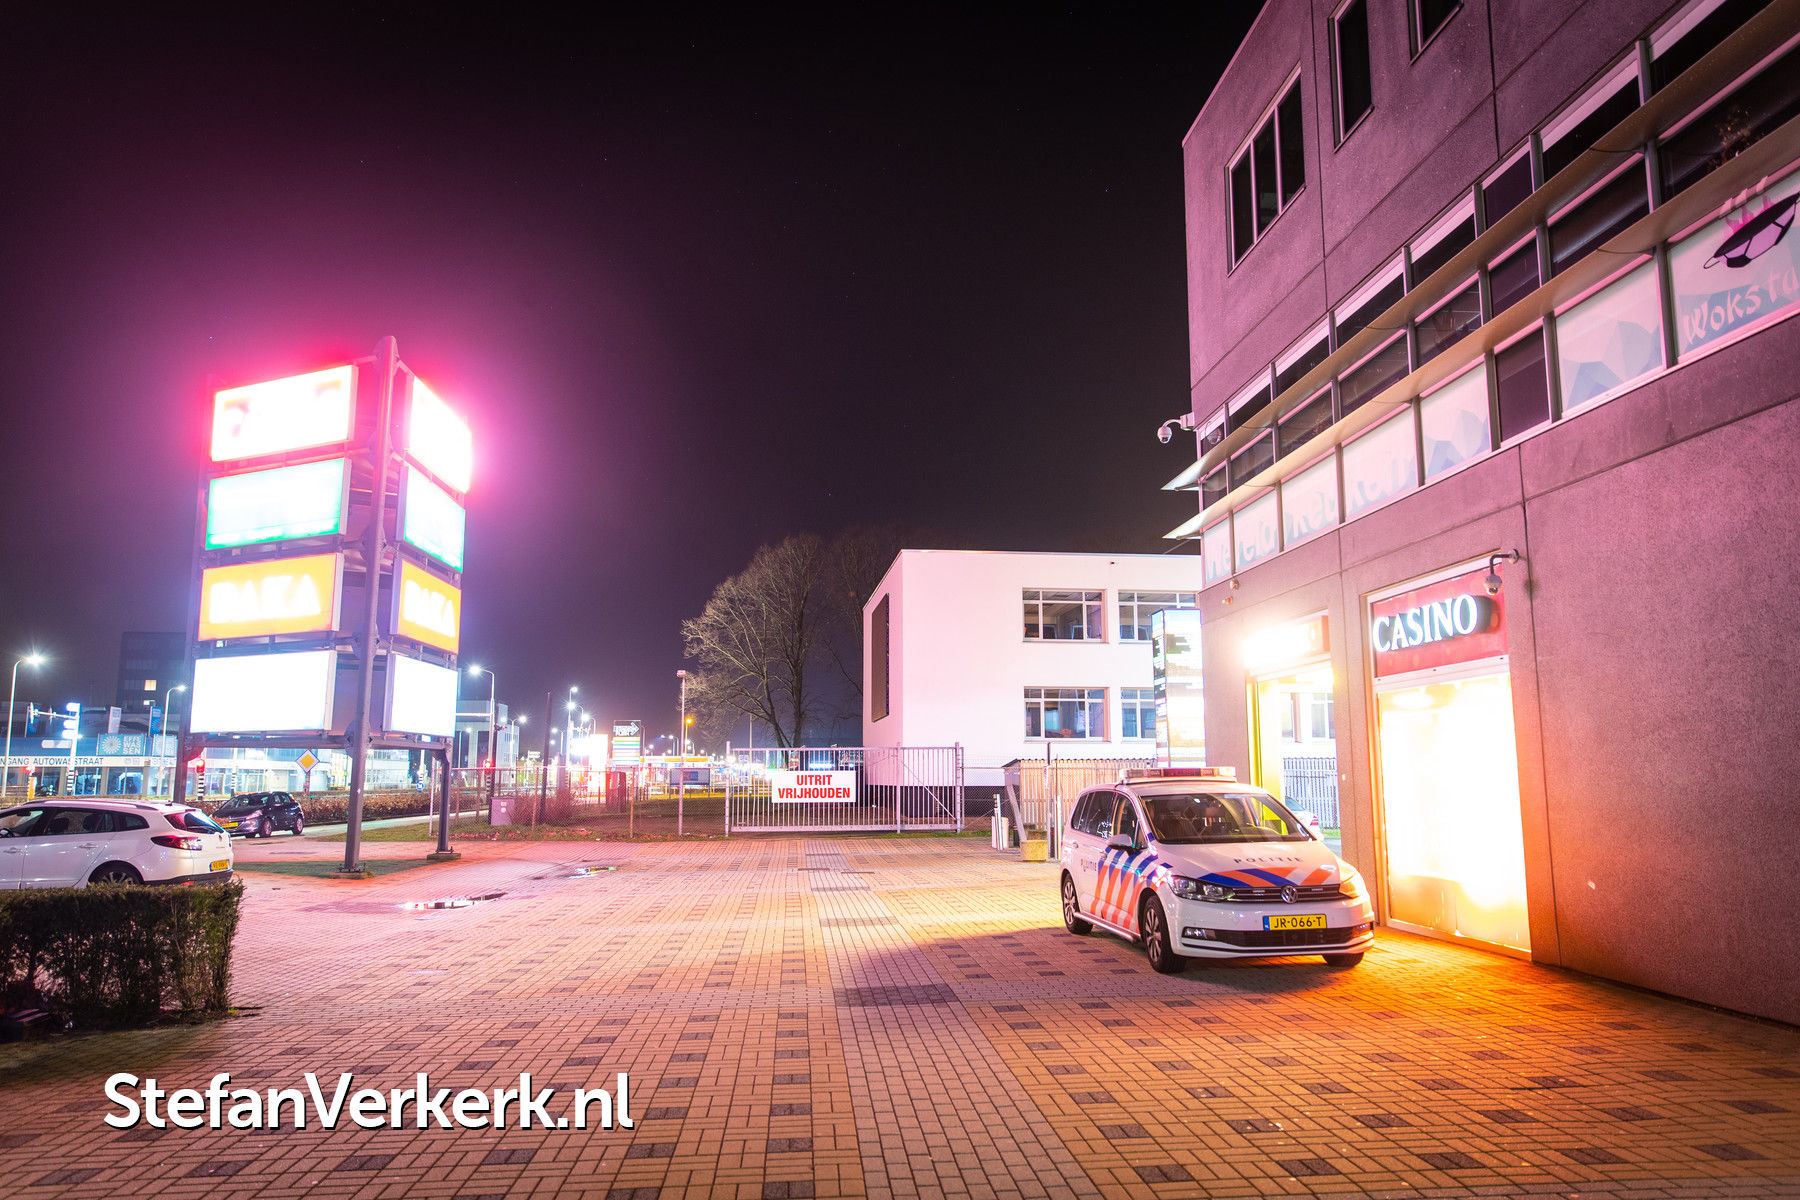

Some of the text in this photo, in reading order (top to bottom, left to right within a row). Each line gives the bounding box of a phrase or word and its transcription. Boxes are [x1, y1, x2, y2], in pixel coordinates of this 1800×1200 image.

[1373, 594, 1478, 652] CASINO
[796, 774, 833, 786] UITRIT
[778, 787, 851, 799] VRIJHOUDEN
[1274, 916, 1322, 929] JR-066-T
